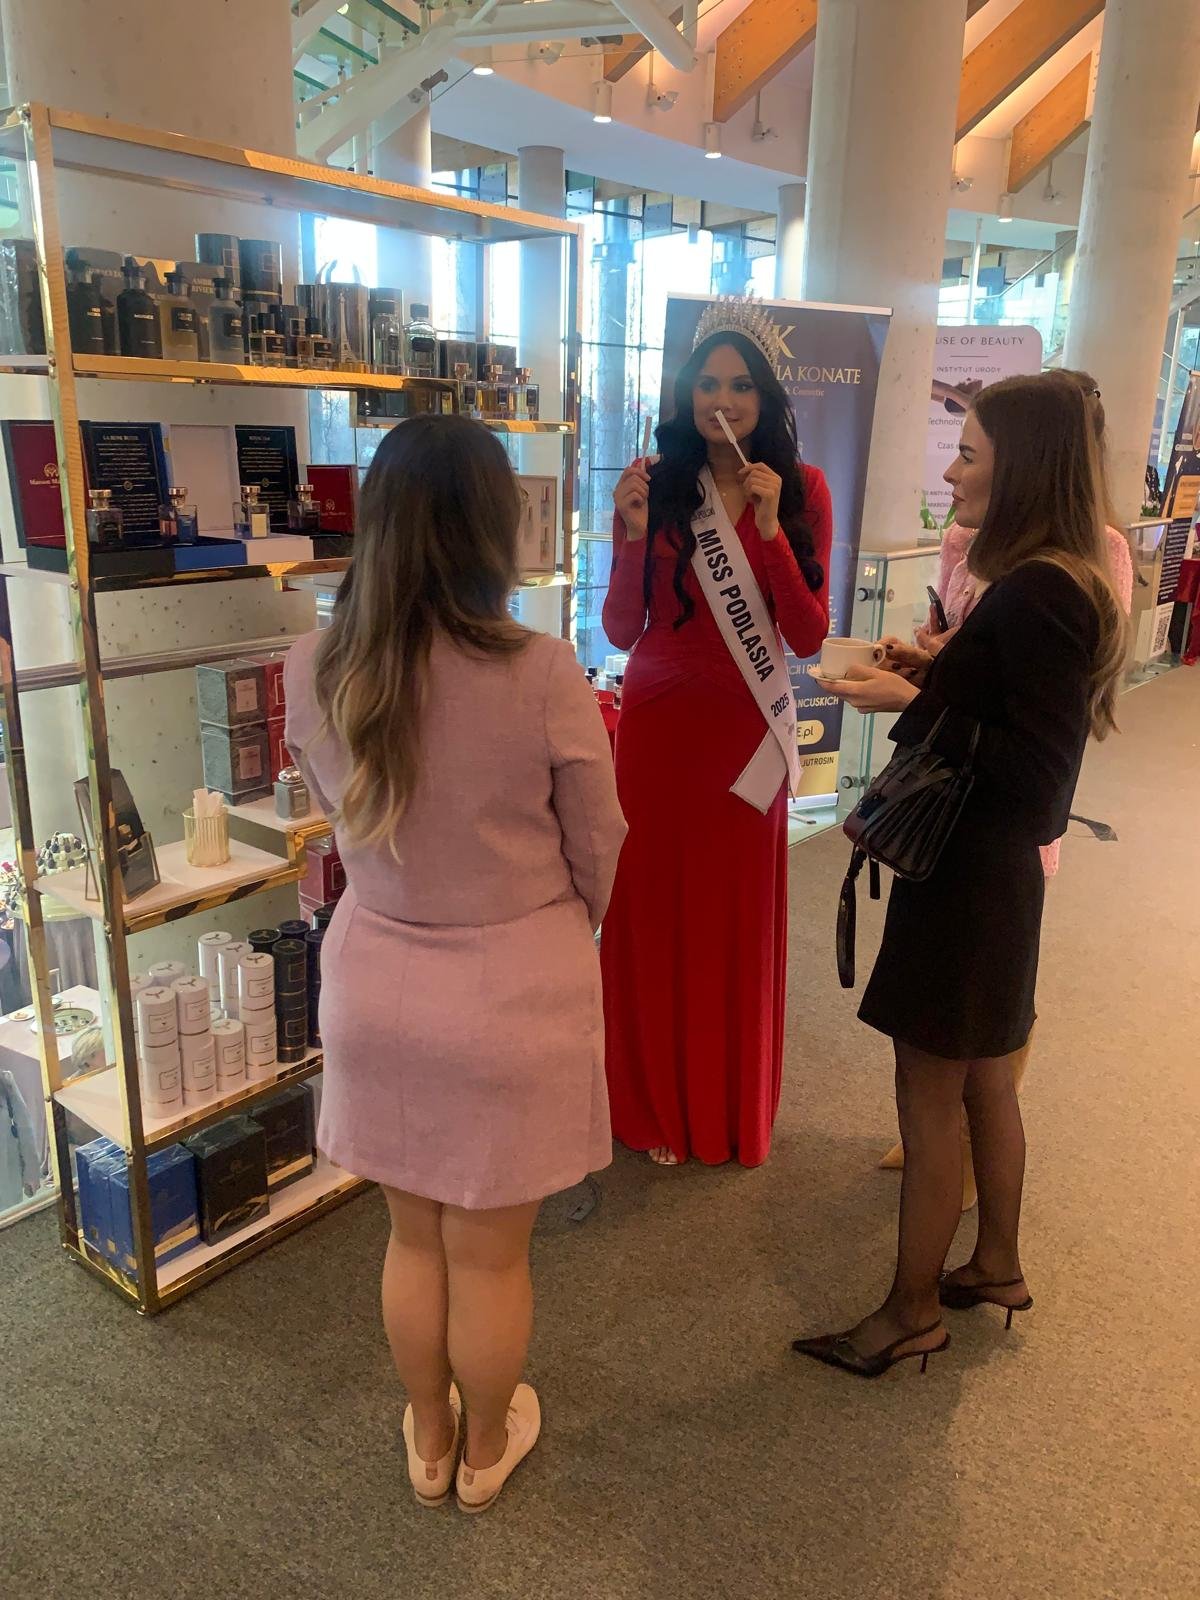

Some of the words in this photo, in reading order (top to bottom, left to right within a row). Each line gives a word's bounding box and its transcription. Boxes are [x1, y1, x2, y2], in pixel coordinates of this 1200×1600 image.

[935, 336, 956, 345] USE
[960, 336, 976, 345] OF
[980, 336, 1025, 346] BEAUTY
[797, 365, 861, 385] KONATE
[697, 528, 734, 582] MISS
[719, 584, 775, 682] PODLASIA
[770, 692, 790, 718] 2025
[798, 695, 839, 709] NCUSKICH
[796, 725, 814, 740] E.pl
[801, 756, 834, 768] JUTROSIN
